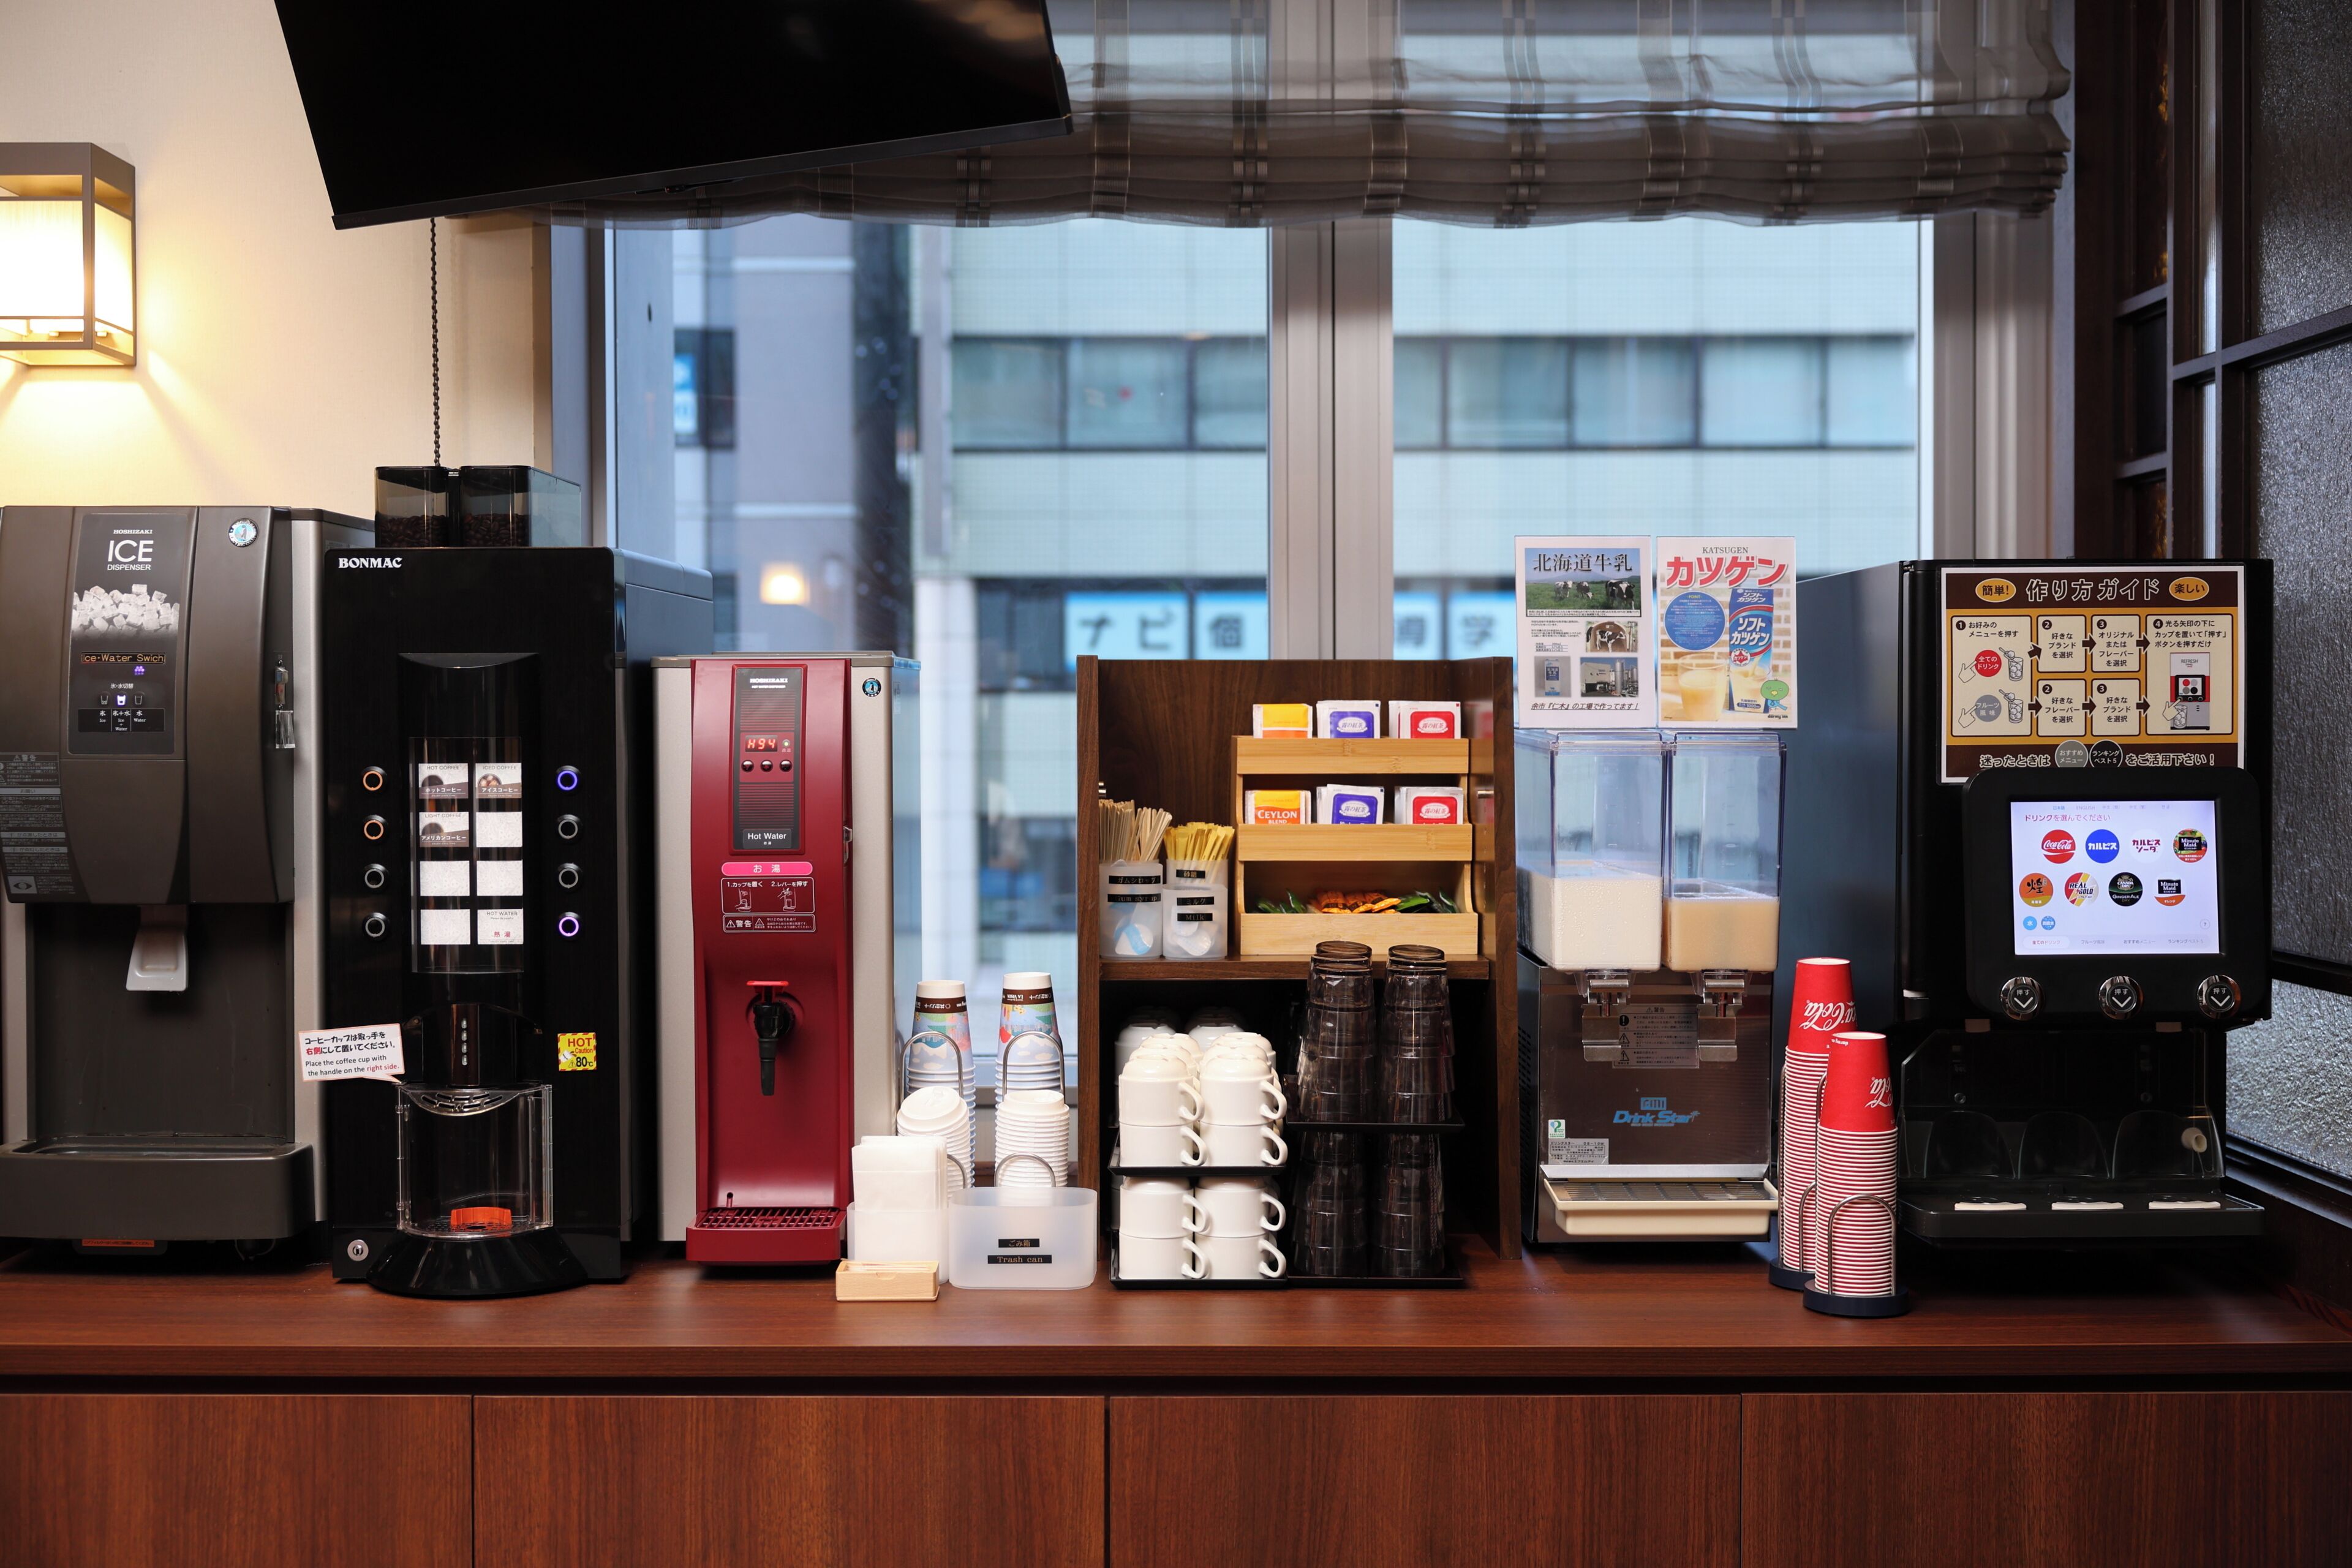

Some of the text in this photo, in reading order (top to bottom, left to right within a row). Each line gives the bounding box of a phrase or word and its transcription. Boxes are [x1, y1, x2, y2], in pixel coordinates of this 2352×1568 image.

[108, 540, 154, 562] ICE
[338, 557, 402, 568] BONMAC
[1533, 553, 1632, 572] 北海道牛乳
[1666, 556, 1787, 587] カツゲン
[2026, 578, 2160, 601] 作り方ガイド
[1738, 617, 1766, 631] ソフト
[1730, 631, 1770, 646] カツゲン
[1980, 754, 2051, 767] 迷ったときは
[1257, 810, 1297, 818] CEYLON
[305, 1031, 385, 1044] コーヒーカップは取っ手を
[568, 1038, 592, 1047] HOT
[306, 1041, 395, 1055] 右側にして置いてください。
[1613, 1110, 1692, 1123] Drink Star
